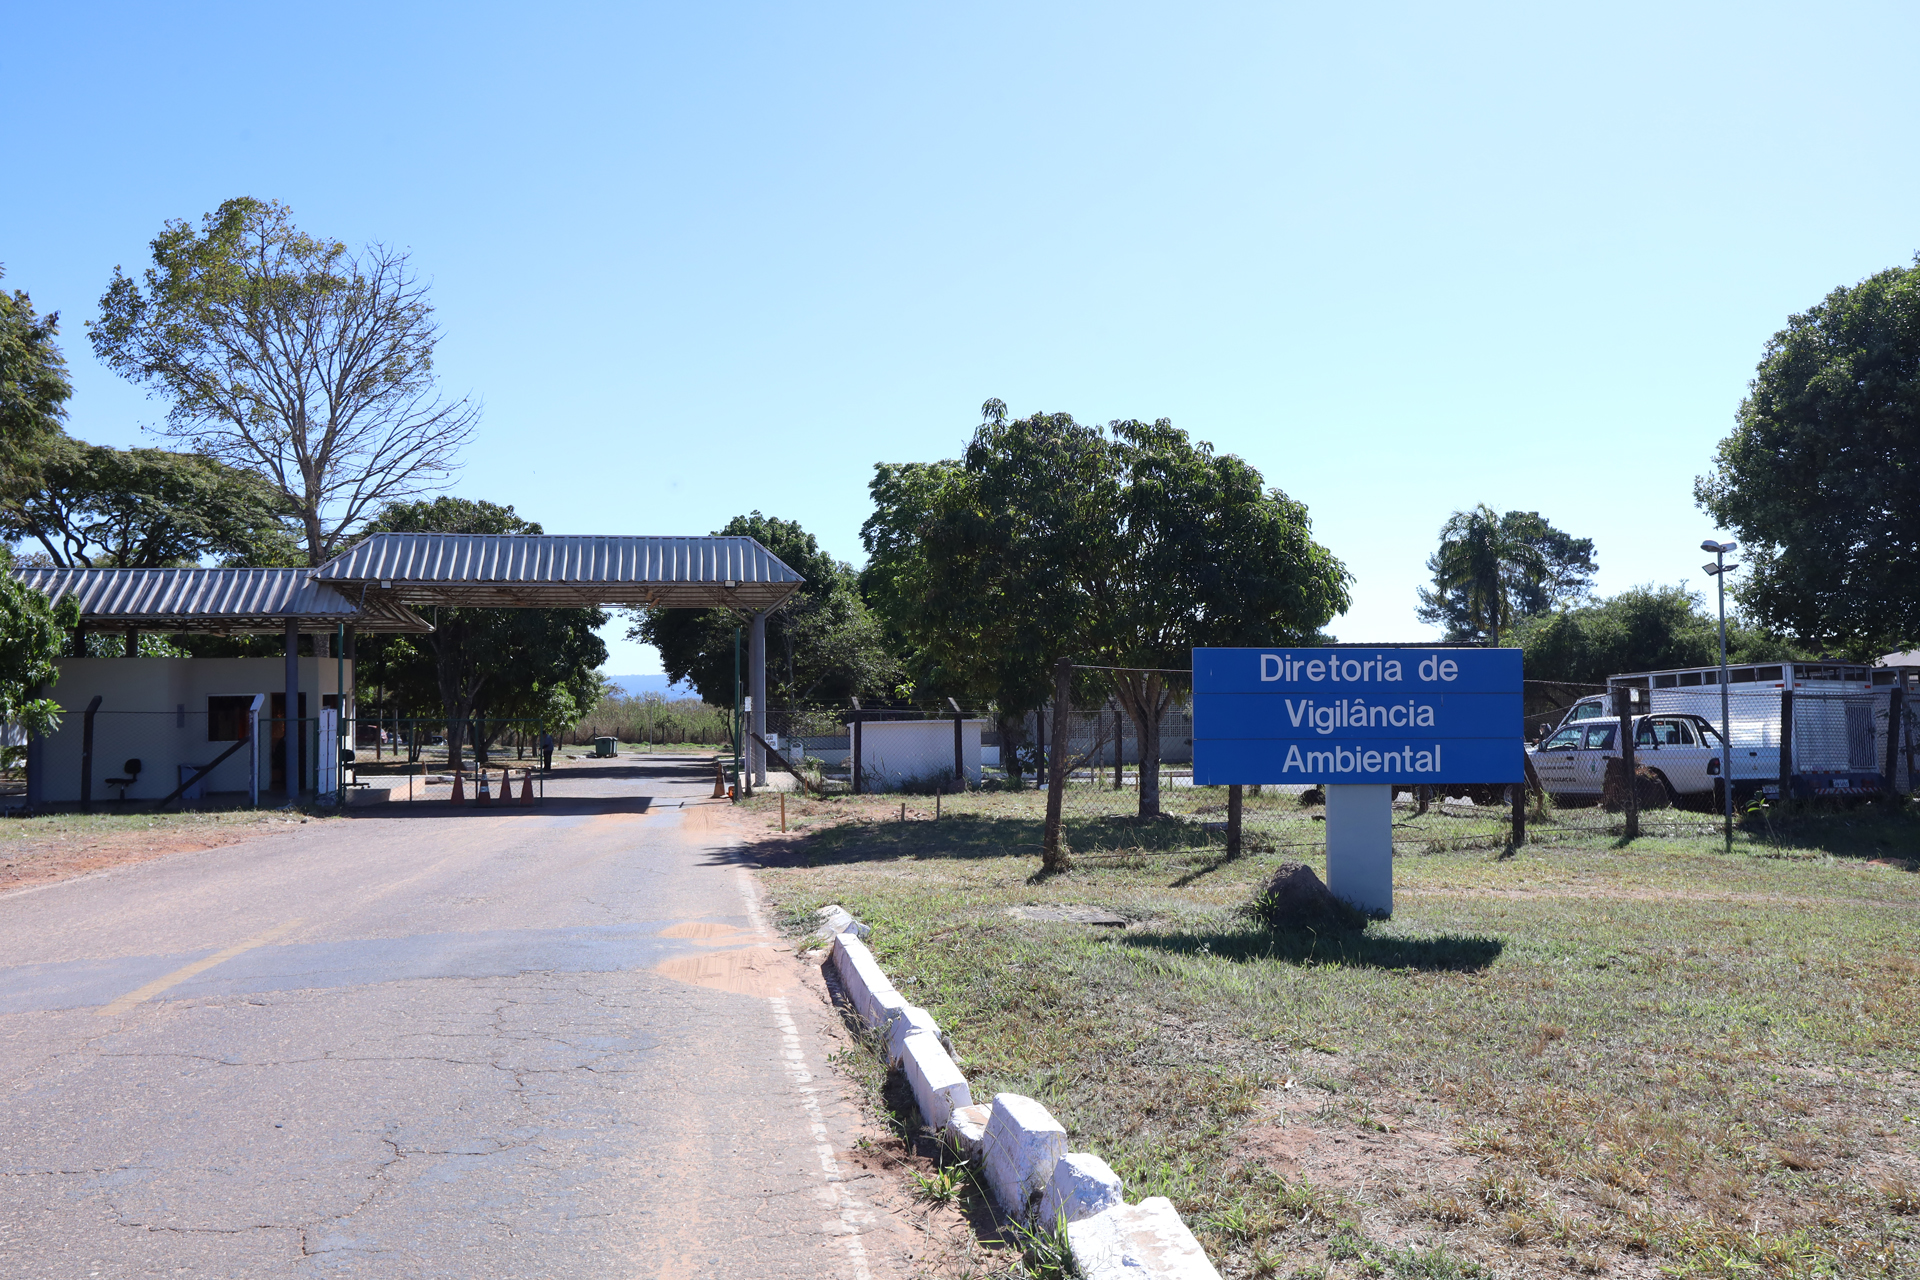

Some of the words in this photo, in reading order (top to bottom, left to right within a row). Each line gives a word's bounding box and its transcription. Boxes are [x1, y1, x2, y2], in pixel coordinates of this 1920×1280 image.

[1260, 654, 1402, 682] Diretoria
[1418, 654, 1458, 682] de
[1284, 698, 1435, 735] Vigilância
[1281, 744, 1441, 773] Ambiental
